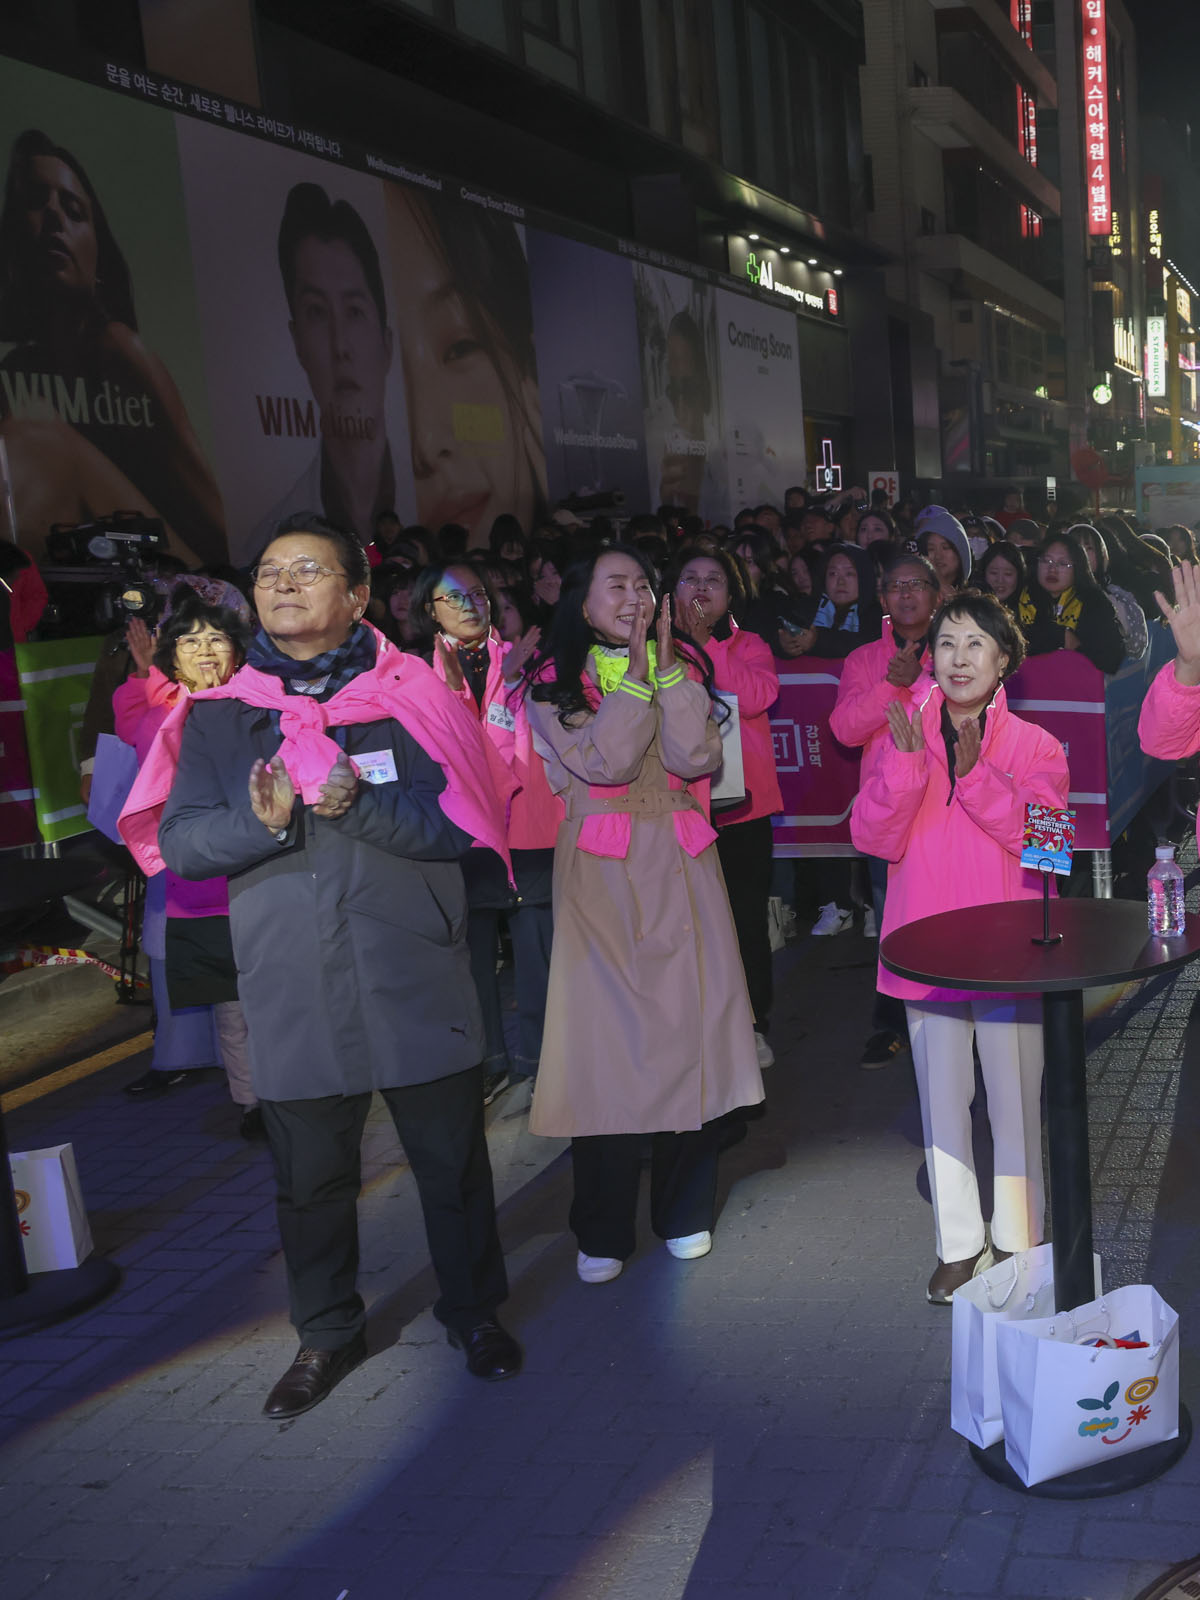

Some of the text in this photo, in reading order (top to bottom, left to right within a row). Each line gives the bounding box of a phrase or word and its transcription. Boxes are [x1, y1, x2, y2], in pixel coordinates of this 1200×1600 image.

[105, 63, 131, 88] 문을
[133, 73, 158, 96] 여는
[190, 94, 222, 118] 새로운
[257, 117, 295, 142] 라이프가
[728, 321, 792, 361] Coming Soon
[1, 370, 154, 427] WIM diet
[256, 395, 316, 438] WIM
[805, 725, 822, 768] 강남역
[1034, 824, 1064, 835] FESTIVAL
